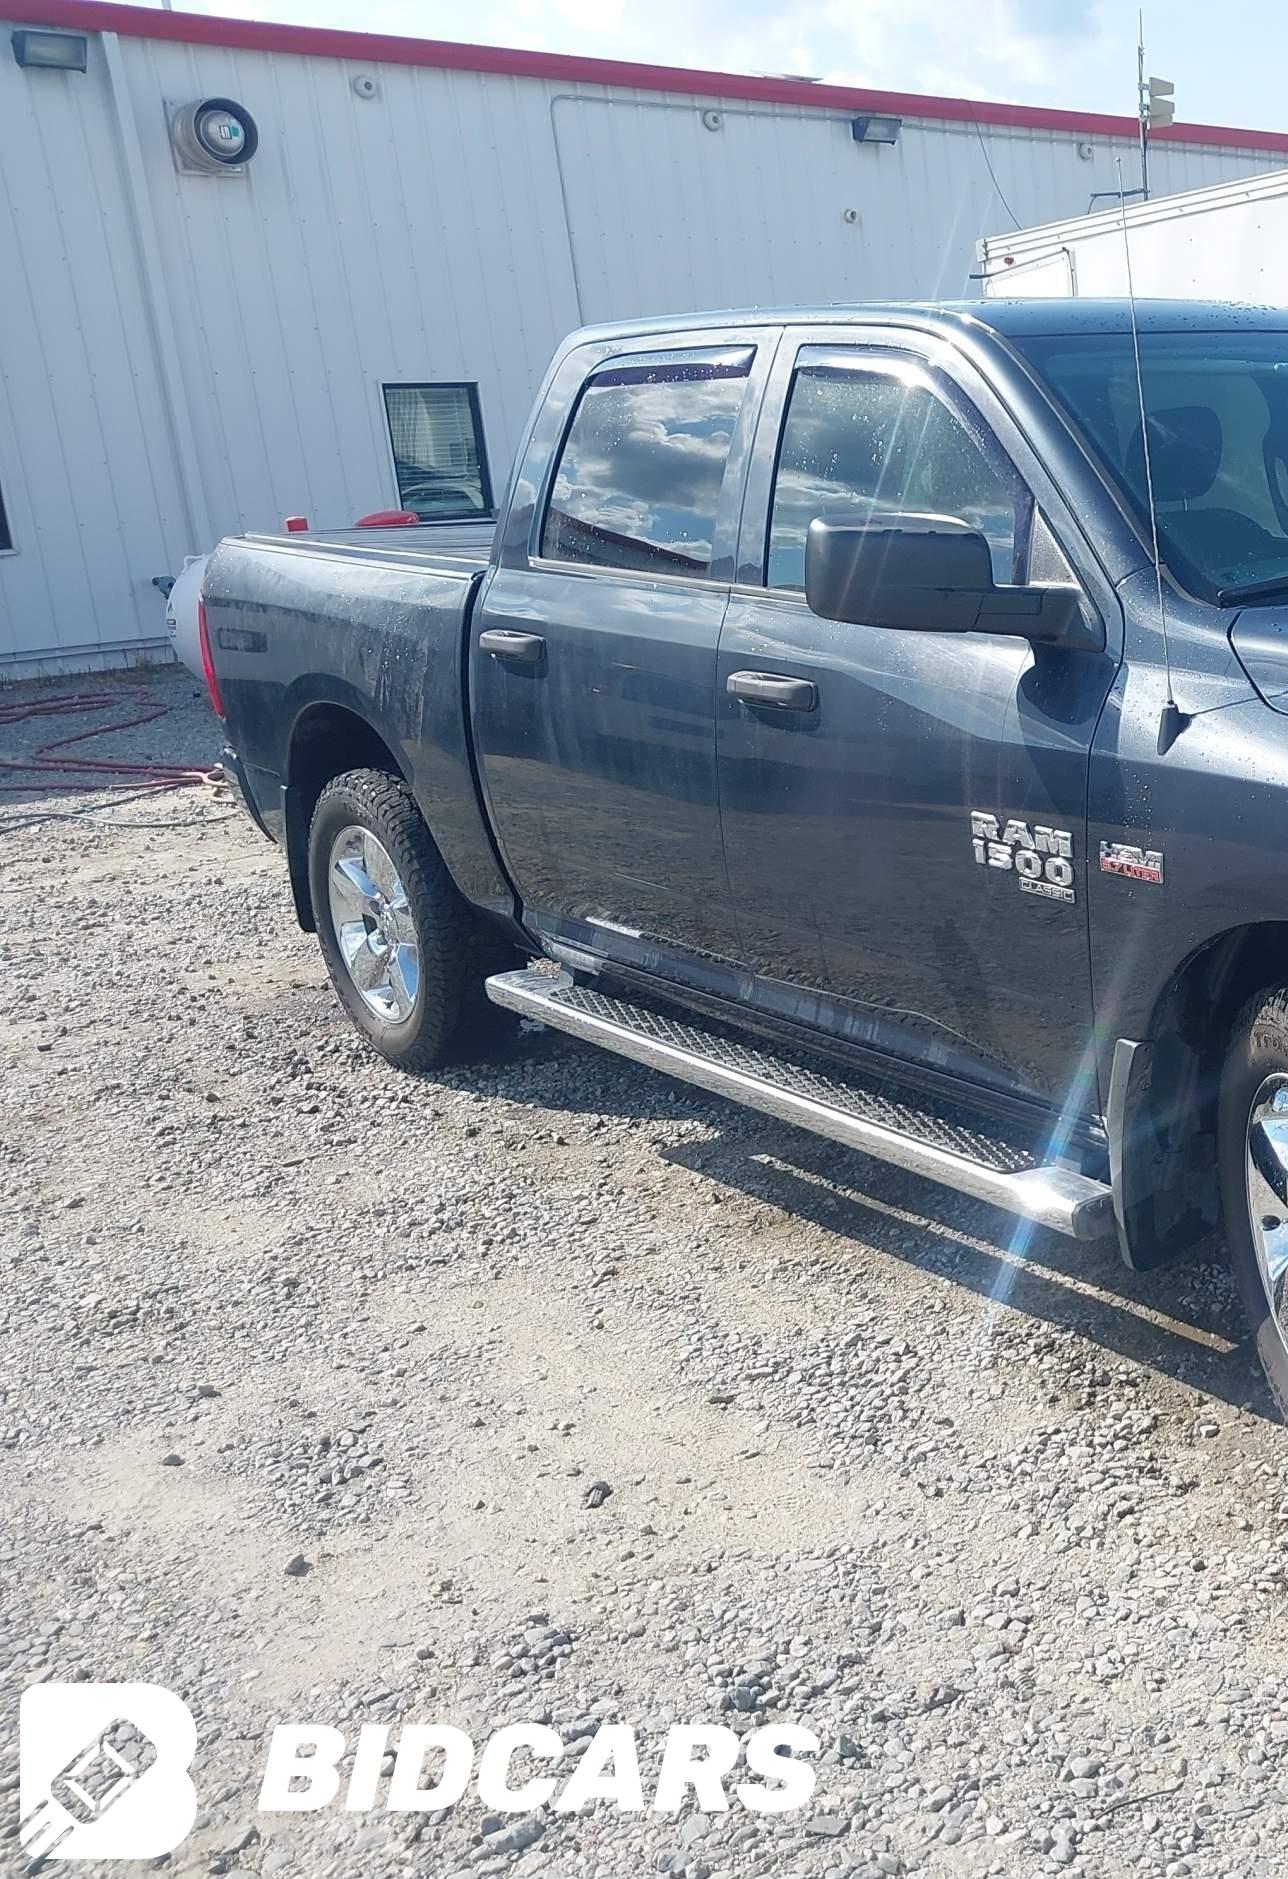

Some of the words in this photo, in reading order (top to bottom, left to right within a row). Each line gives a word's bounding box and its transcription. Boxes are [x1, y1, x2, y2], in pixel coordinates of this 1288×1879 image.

[971, 810, 1073, 858] RAM
[972, 838, 1073, 887] 1500
[1123, 863, 1160, 881] LITER
[1021, 879, 1073, 900] CLASSIC
